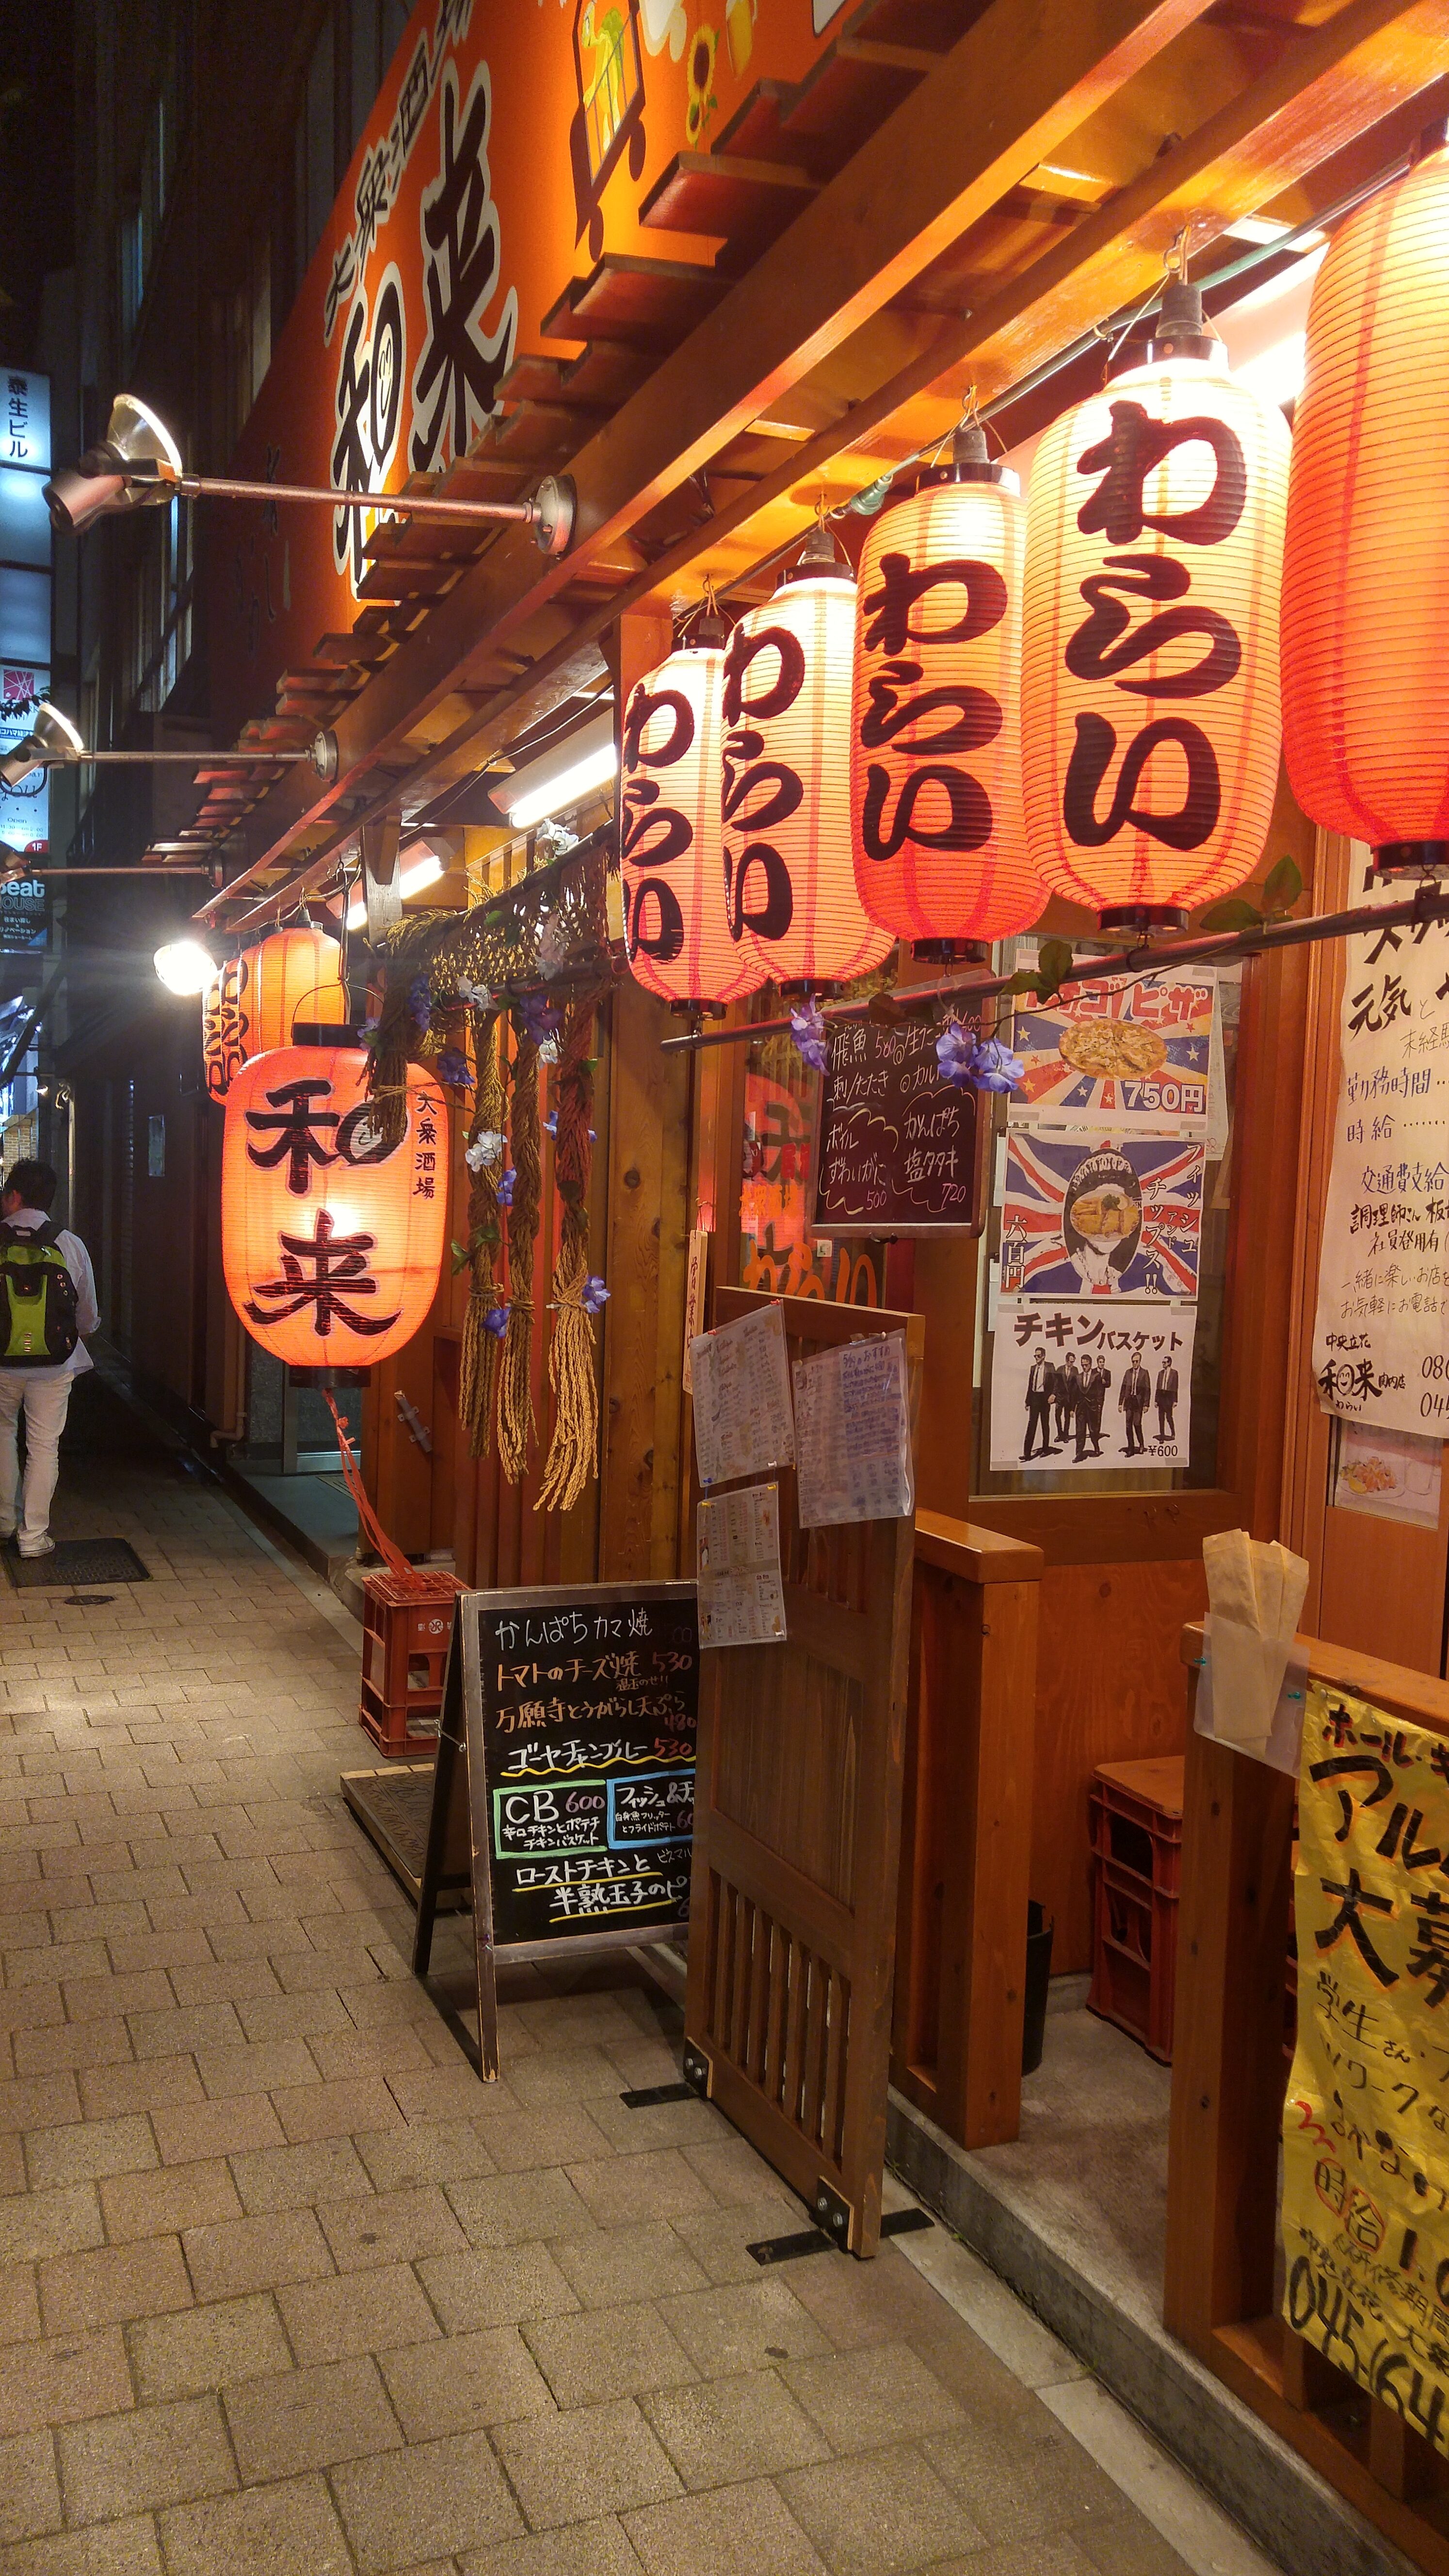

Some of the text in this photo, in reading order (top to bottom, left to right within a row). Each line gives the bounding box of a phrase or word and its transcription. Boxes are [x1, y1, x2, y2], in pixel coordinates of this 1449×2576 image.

[1063, 400, 1247, 850] わらい
[862, 553, 1008, 861] わらい
[722, 623, 805, 942] わらい
[622, 683, 694, 964] わらい
[32, 842, 42, 851] 1F
[0, 896, 45, 911] OUSE
[831, 1029, 867, 1072] 飛魚
[1123, 1080, 1205, 1113] 750円
[1348, 1065, 1431, 1107] 勤務時間
[413, 1091, 436, 1201] 大衆酒場
[826, 1123, 859, 1152] ボイル
[1346, 1114, 1396, 1146] 時給
[1361, 1161, 1449, 1194] 交通費支給
[244, 1078, 411, 1336] 和来
[866, 1190, 887, 1210] 500
[941, 1183, 966, 1210] 720
[1166, 1211, 1177, 1251] アンド
[1005, 1214, 1030, 1290] 六百円
[1014, 1312, 1184, 1352] チキンバスケット
[1325, 1332, 1371, 1352] 中央立花
[1318, 1358, 1383, 1402] 和来
[1335, 1399, 1362, 1412] わらい
[1148, 1445, 1179, 1457] ¥600
[498, 1651, 693, 1691] トマトのチーズ焼 530
[654, 1737, 693, 1757] 530
[505, 1790, 606, 1824] CB 600
[1309, 1754, 1449, 1880] アル
[523, 1831, 599, 1851] チキンバスケット
[516, 1853, 651, 1885] ローストチキンと
